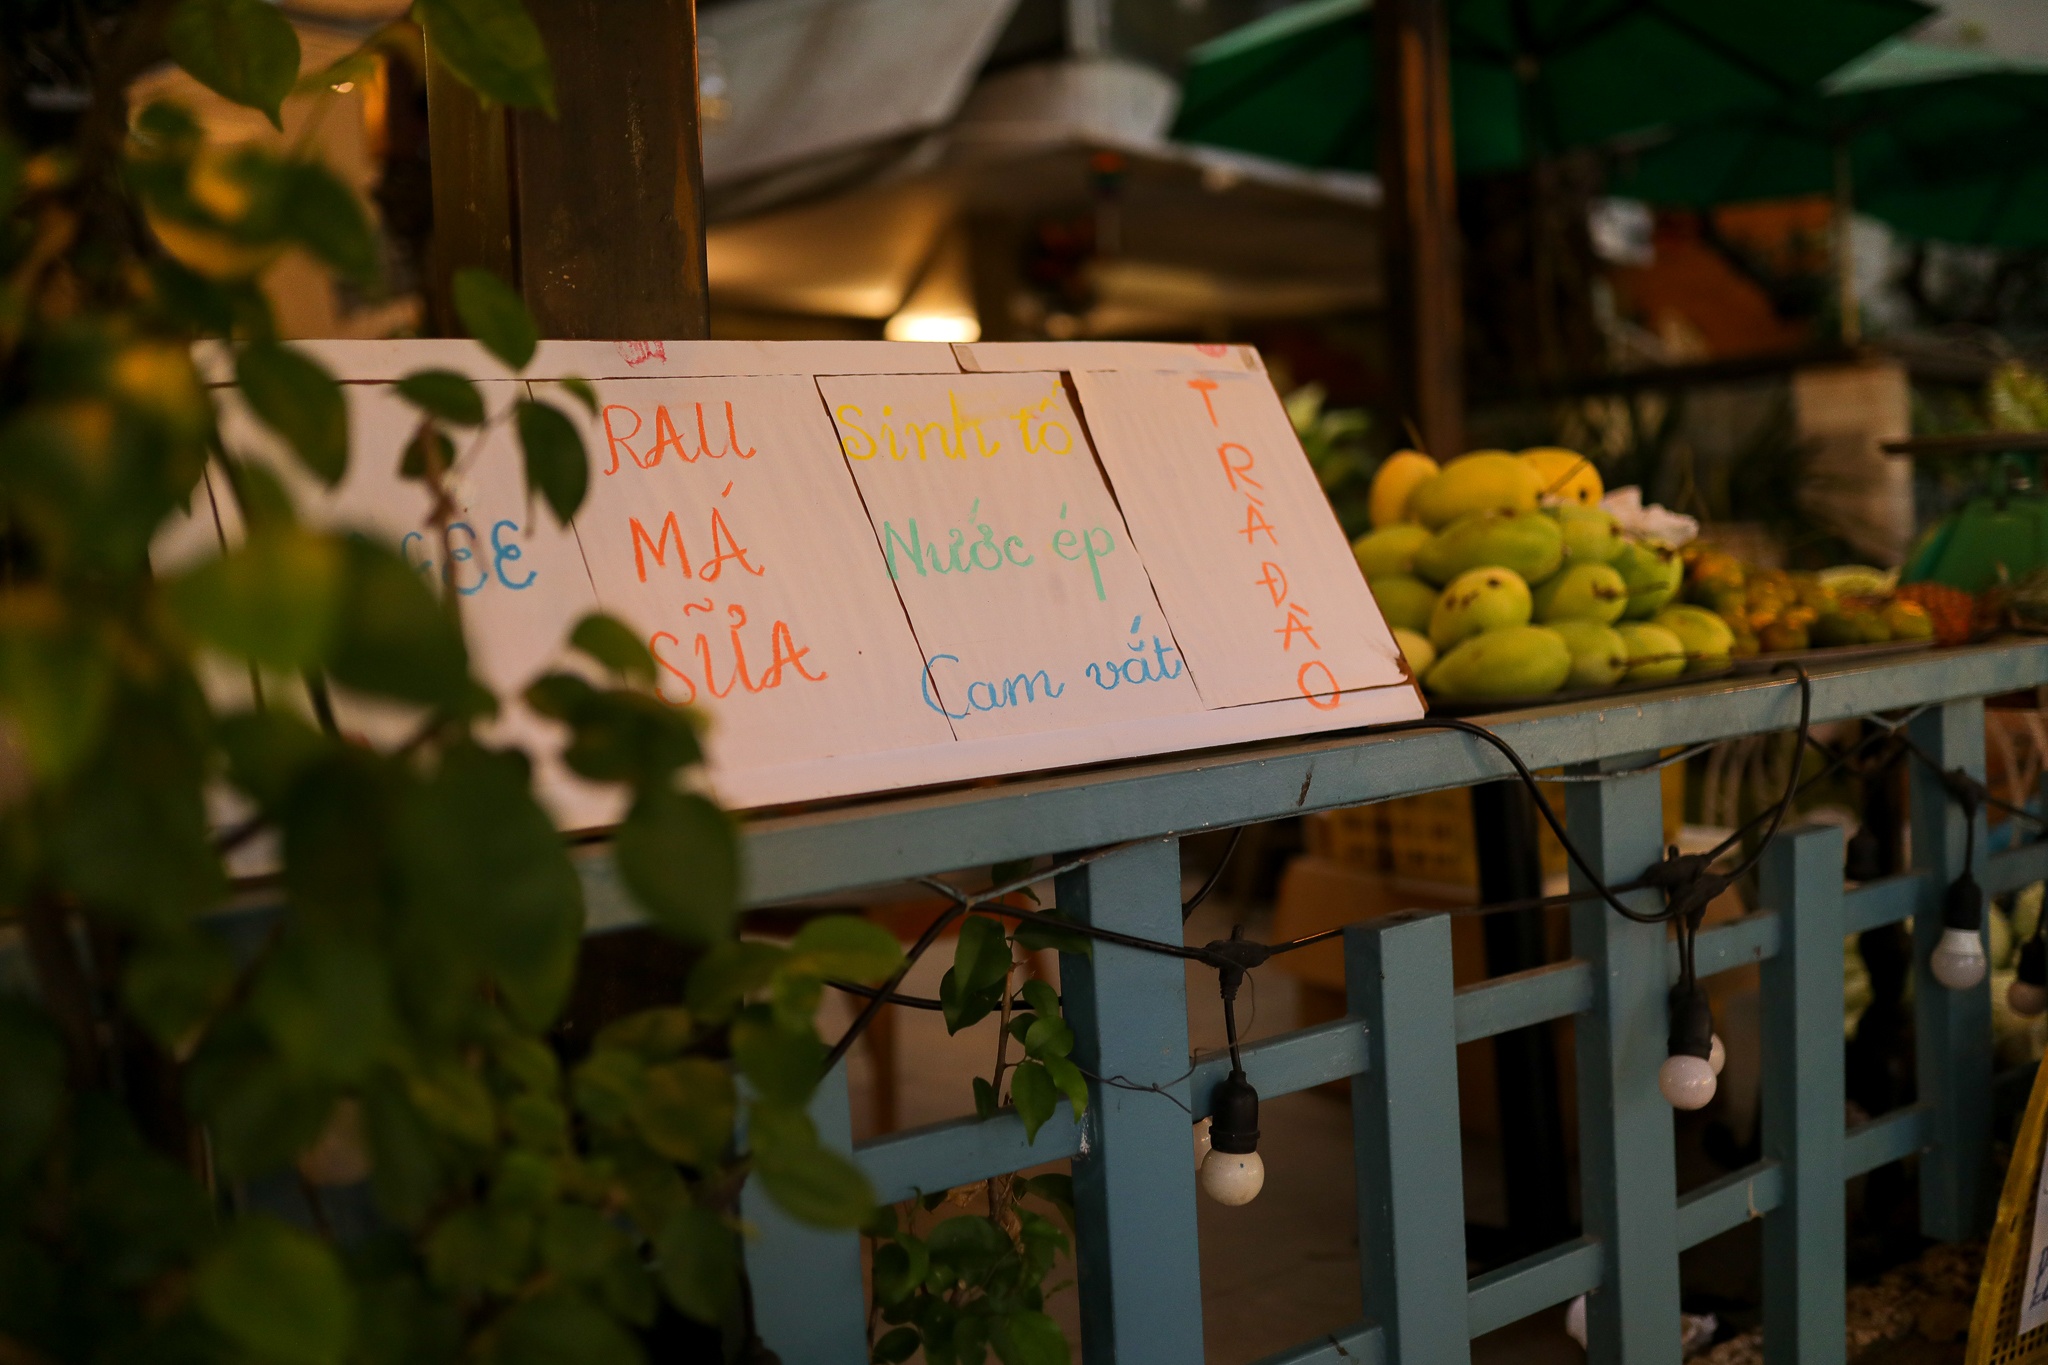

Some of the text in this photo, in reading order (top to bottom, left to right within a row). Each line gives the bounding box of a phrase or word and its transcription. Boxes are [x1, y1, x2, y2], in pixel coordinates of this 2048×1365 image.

[602, 400, 757, 476] RAU
[836, 379, 1073, 461] Sinh tố
[629, 480, 766, 583] MÁ
[884, 496, 1116, 603] Nước ép
[921, 615, 1183, 720] Cam vắt
